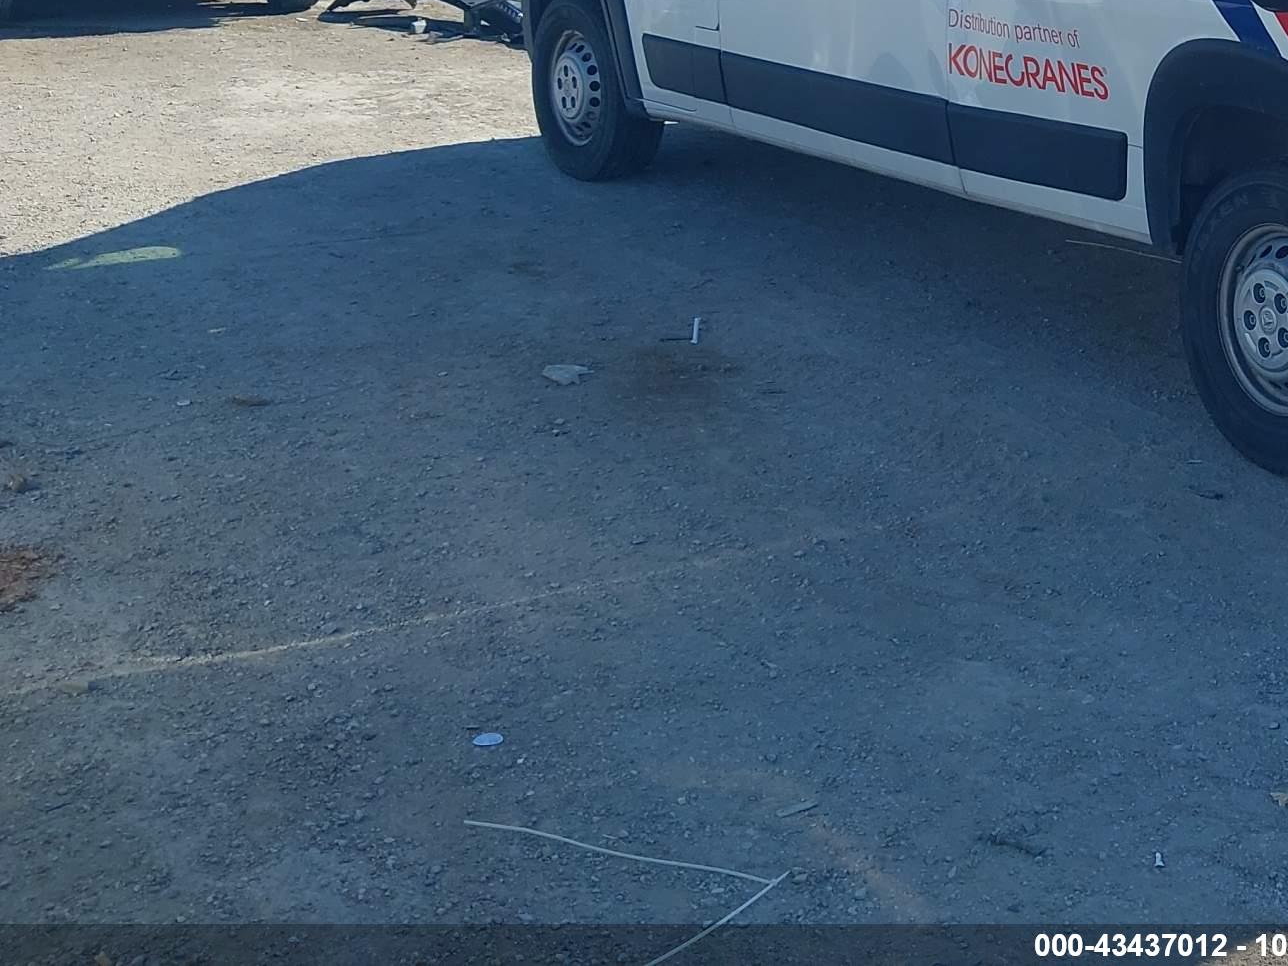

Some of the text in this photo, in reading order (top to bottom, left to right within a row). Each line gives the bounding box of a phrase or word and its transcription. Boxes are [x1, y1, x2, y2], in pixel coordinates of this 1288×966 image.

[948, 8, 1080, 48] Distribution partner of
[948, 43, 1108, 100] KONECRANES
